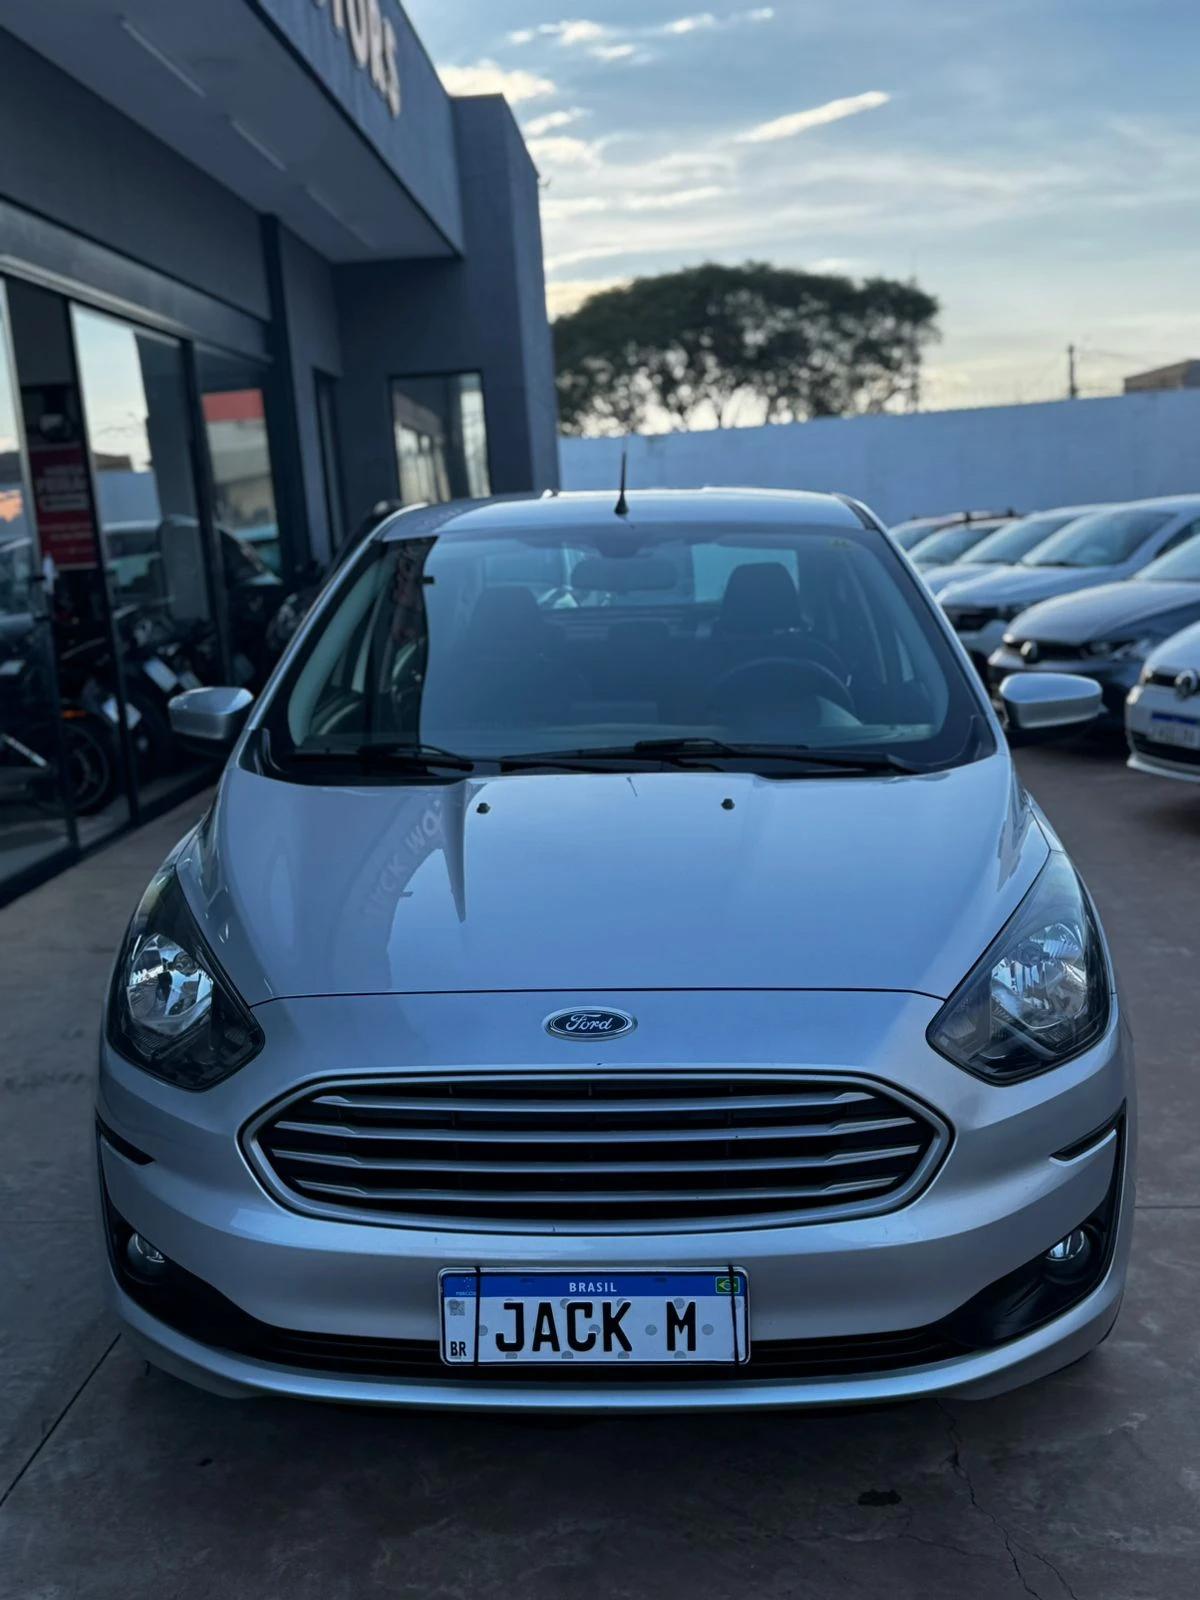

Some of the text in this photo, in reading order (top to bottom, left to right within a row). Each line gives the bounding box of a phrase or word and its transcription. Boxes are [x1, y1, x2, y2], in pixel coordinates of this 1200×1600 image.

[565, 1013, 614, 1031] Ford
[569, 1282, 617, 1293] BRASIL
[495, 1301, 697, 1353] JACK M
[450, 1341, 467, 1357] BR
